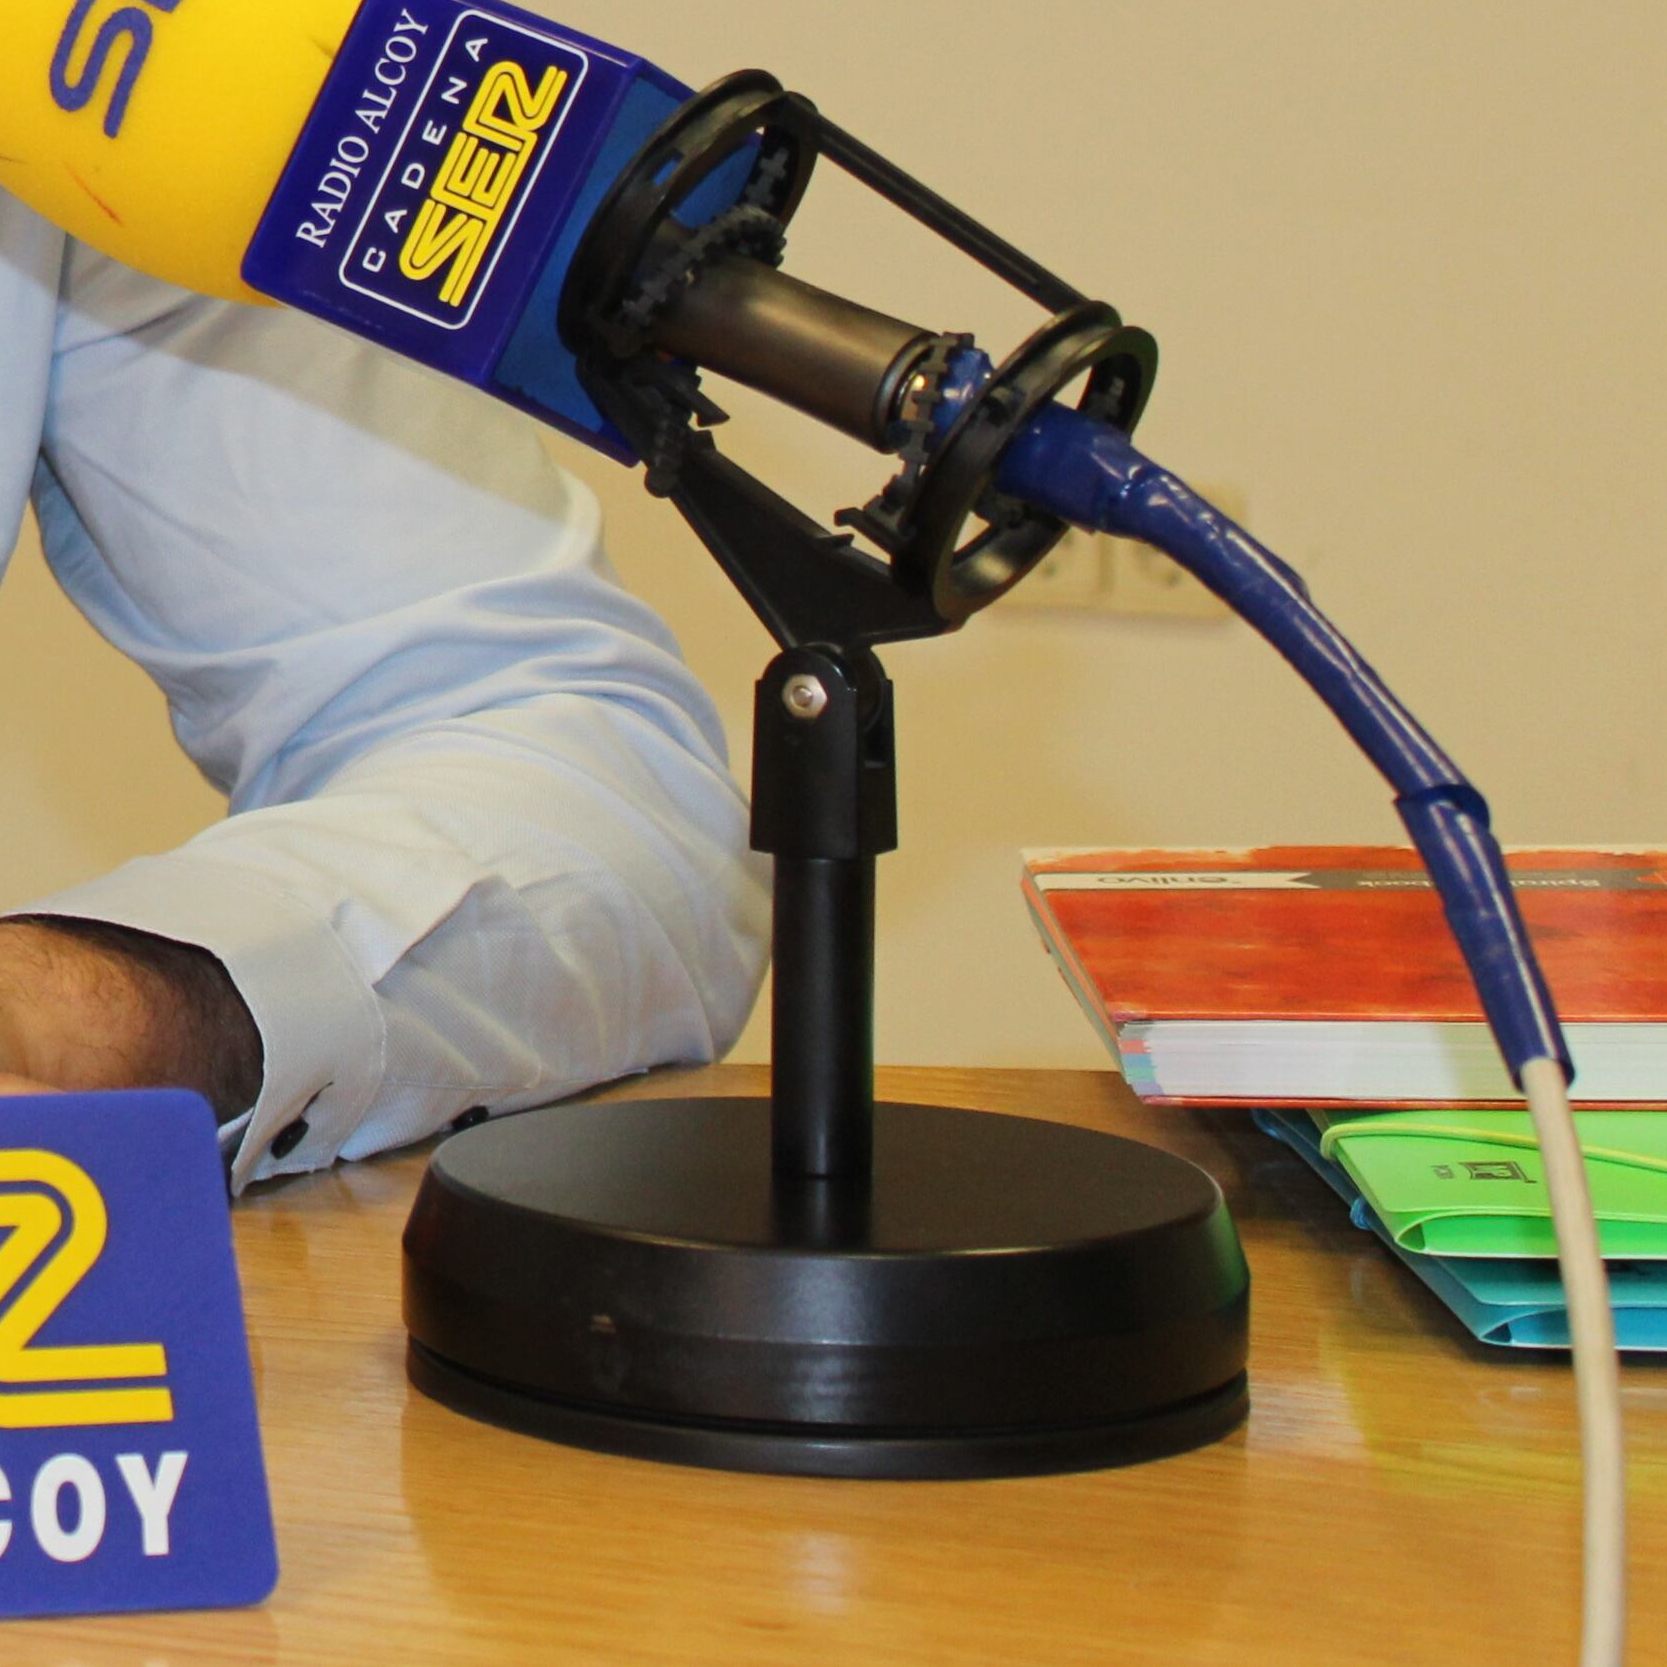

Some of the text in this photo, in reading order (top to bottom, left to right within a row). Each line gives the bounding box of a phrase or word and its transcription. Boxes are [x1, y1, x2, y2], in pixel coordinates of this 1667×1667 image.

[295, 8, 429, 249] RADIO ALCOY
[361, 37, 489, 273] CADENA
[398, 60, 567, 308] SER
